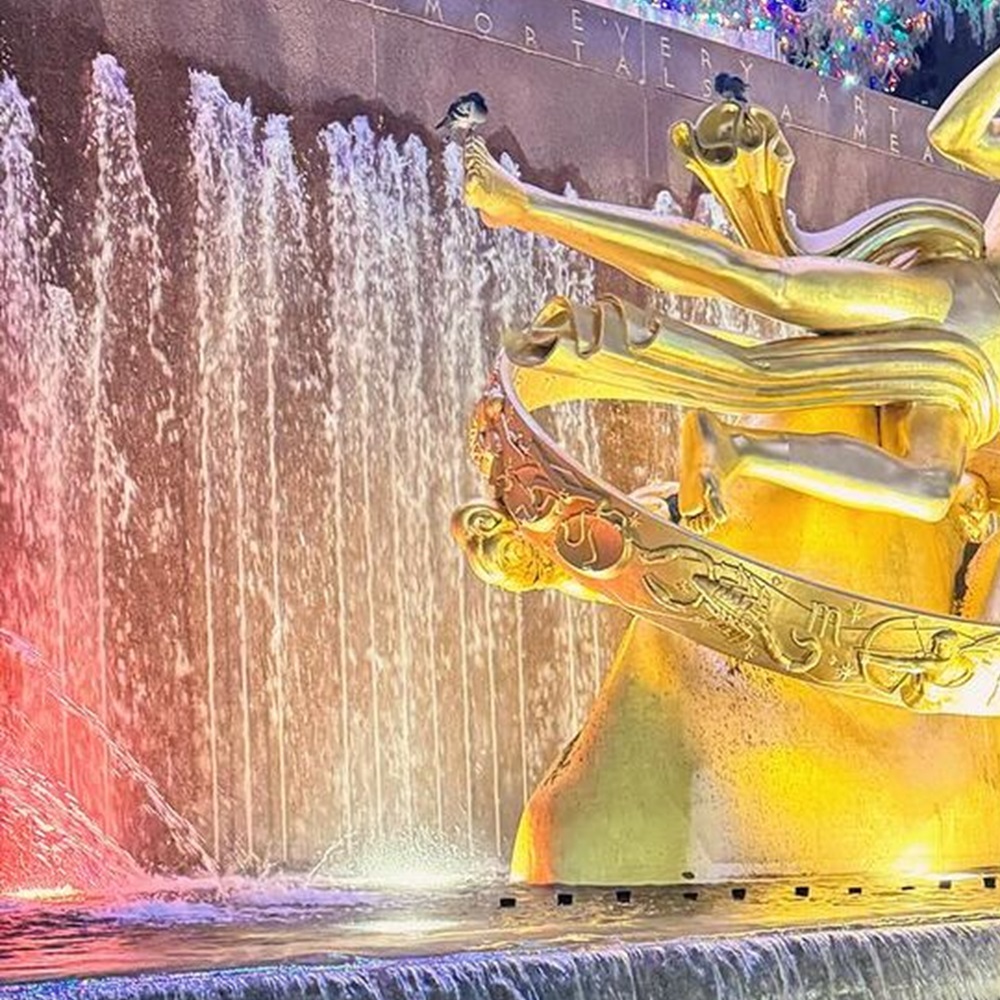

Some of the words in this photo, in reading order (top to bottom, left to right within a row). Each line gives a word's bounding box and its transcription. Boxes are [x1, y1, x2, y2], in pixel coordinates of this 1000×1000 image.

[571, 9, 754, 76] EVERY
[817, 86, 899, 127] ART
[780, 104, 794, 120] A
